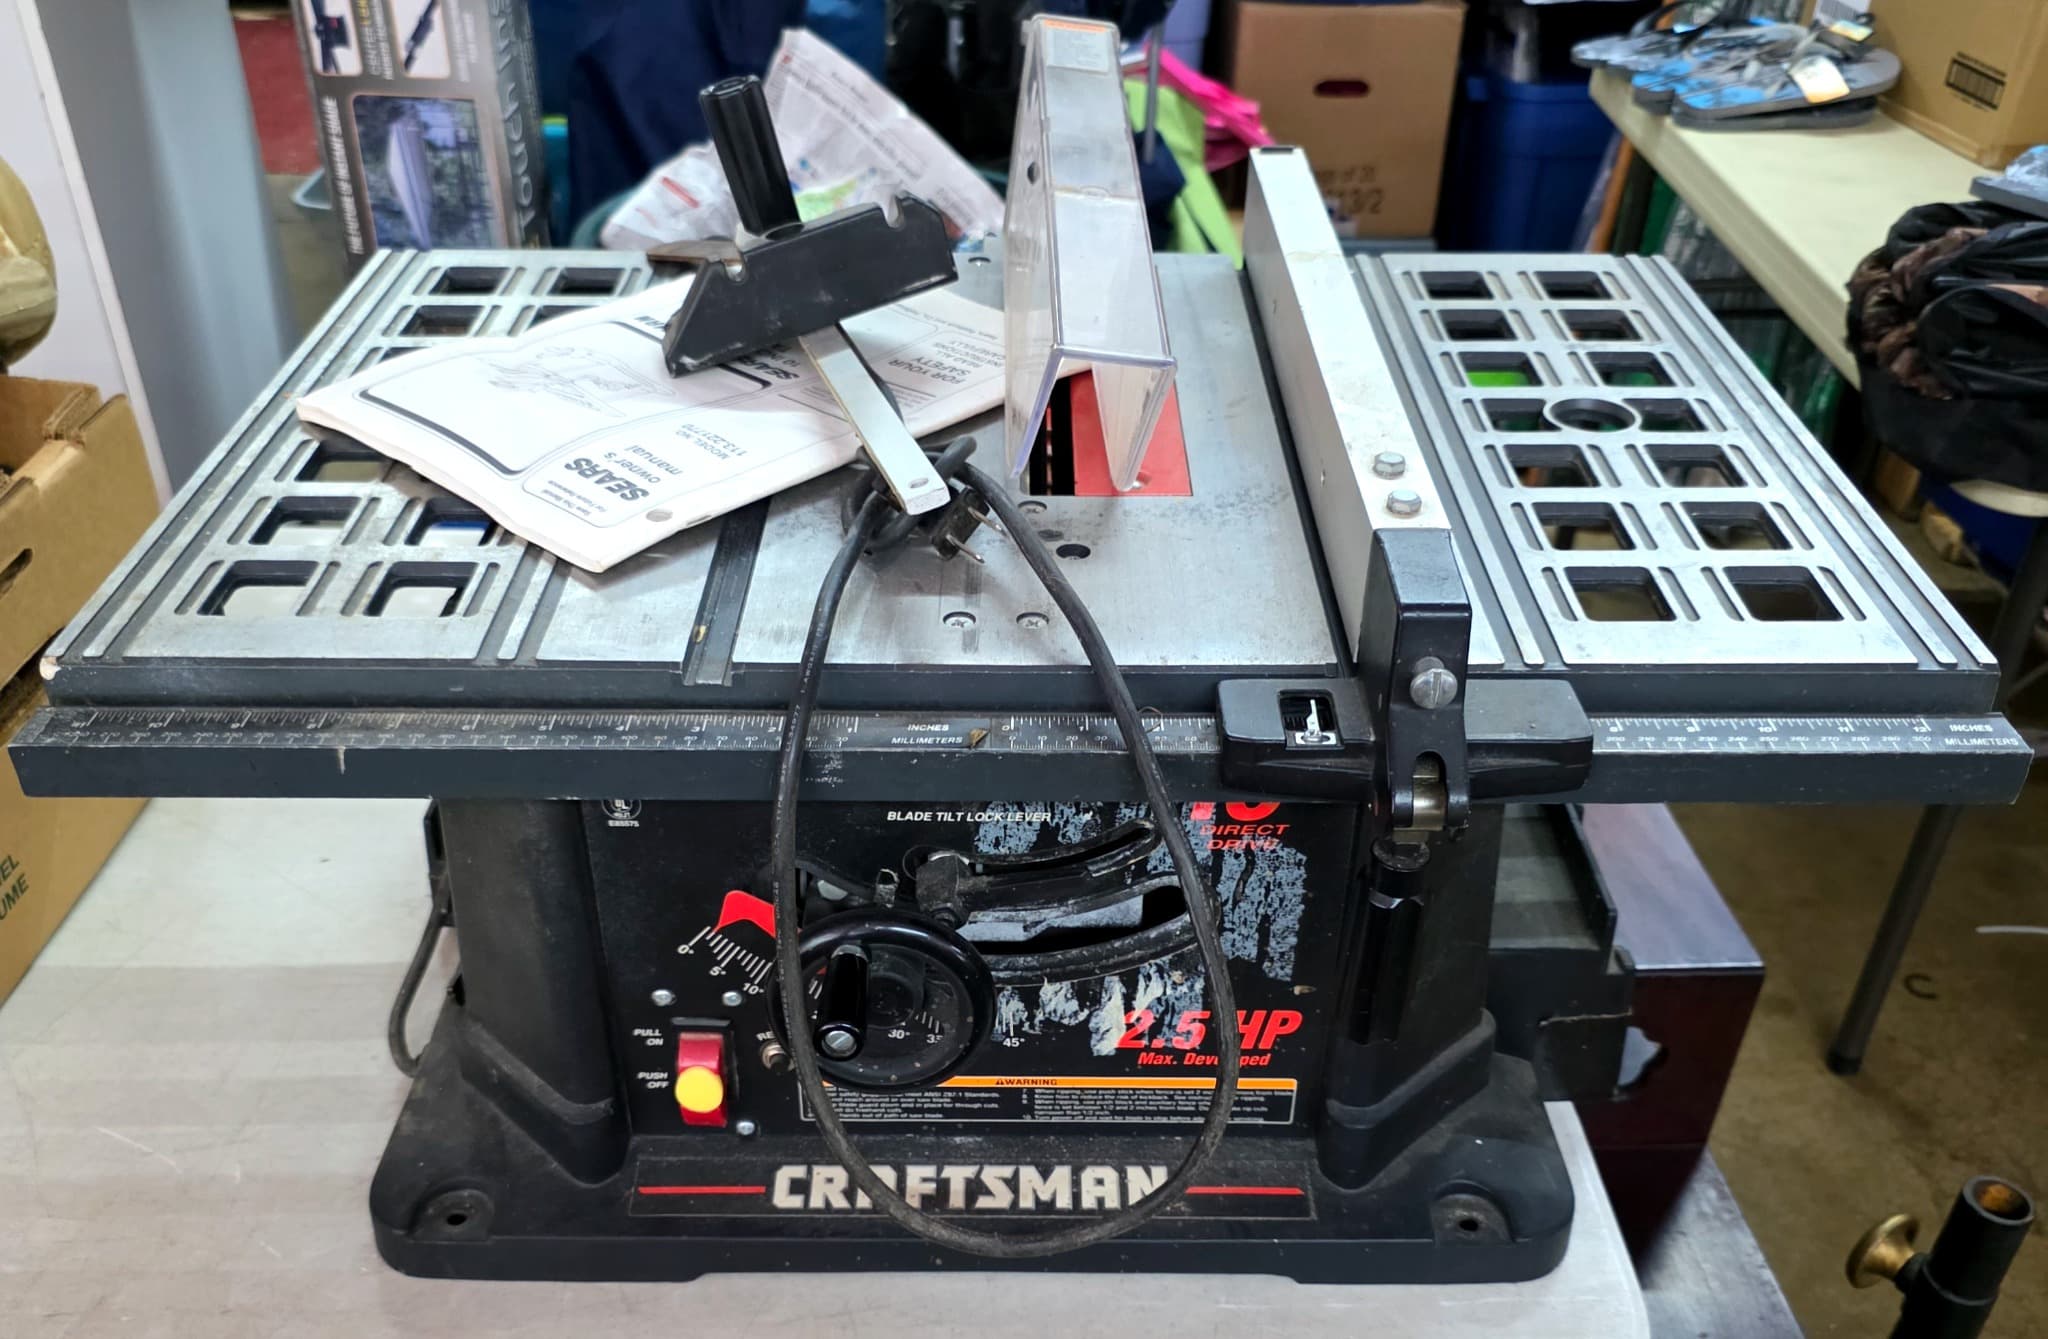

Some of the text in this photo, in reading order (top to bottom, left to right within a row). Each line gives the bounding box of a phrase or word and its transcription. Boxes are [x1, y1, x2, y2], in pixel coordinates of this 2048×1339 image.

[888, 359, 966, 385] FOR YOUR
[912, 356, 972, 377] SAFETY
[693, 437, 730, 460] MODEL
[624, 444, 684, 476] manual
[604, 451, 661, 484] owner's
[564, 457, 650, 502] SEARS
[907, 724, 950, 732] INCHES
[1950, 724, 1993, 733] INCHES
[891, 736, 964, 745] MILLIMETERS
[1945, 737, 2019, 747] MILLIMETERS
[887, 811, 1053, 822] BLADE TILT LOCK LEVER
[1200, 823, 1291, 836] DIRECT
[1206, 838, 1280, 850] DRIVE
[632, 1028, 663, 1037] PULL
[1117, 1009, 1304, 1051] 2.5 HP
[646, 1038, 665, 1046] ON
[1137, 1052, 1271, 1069] Max. Devped
[637, 1071, 669, 1080] PUSH
[647, 1081, 670, 1089] OFF
[1004, 1078, 1058, 1086] WARNING
[772, 1164, 1169, 1211] CRAFTSMAN
